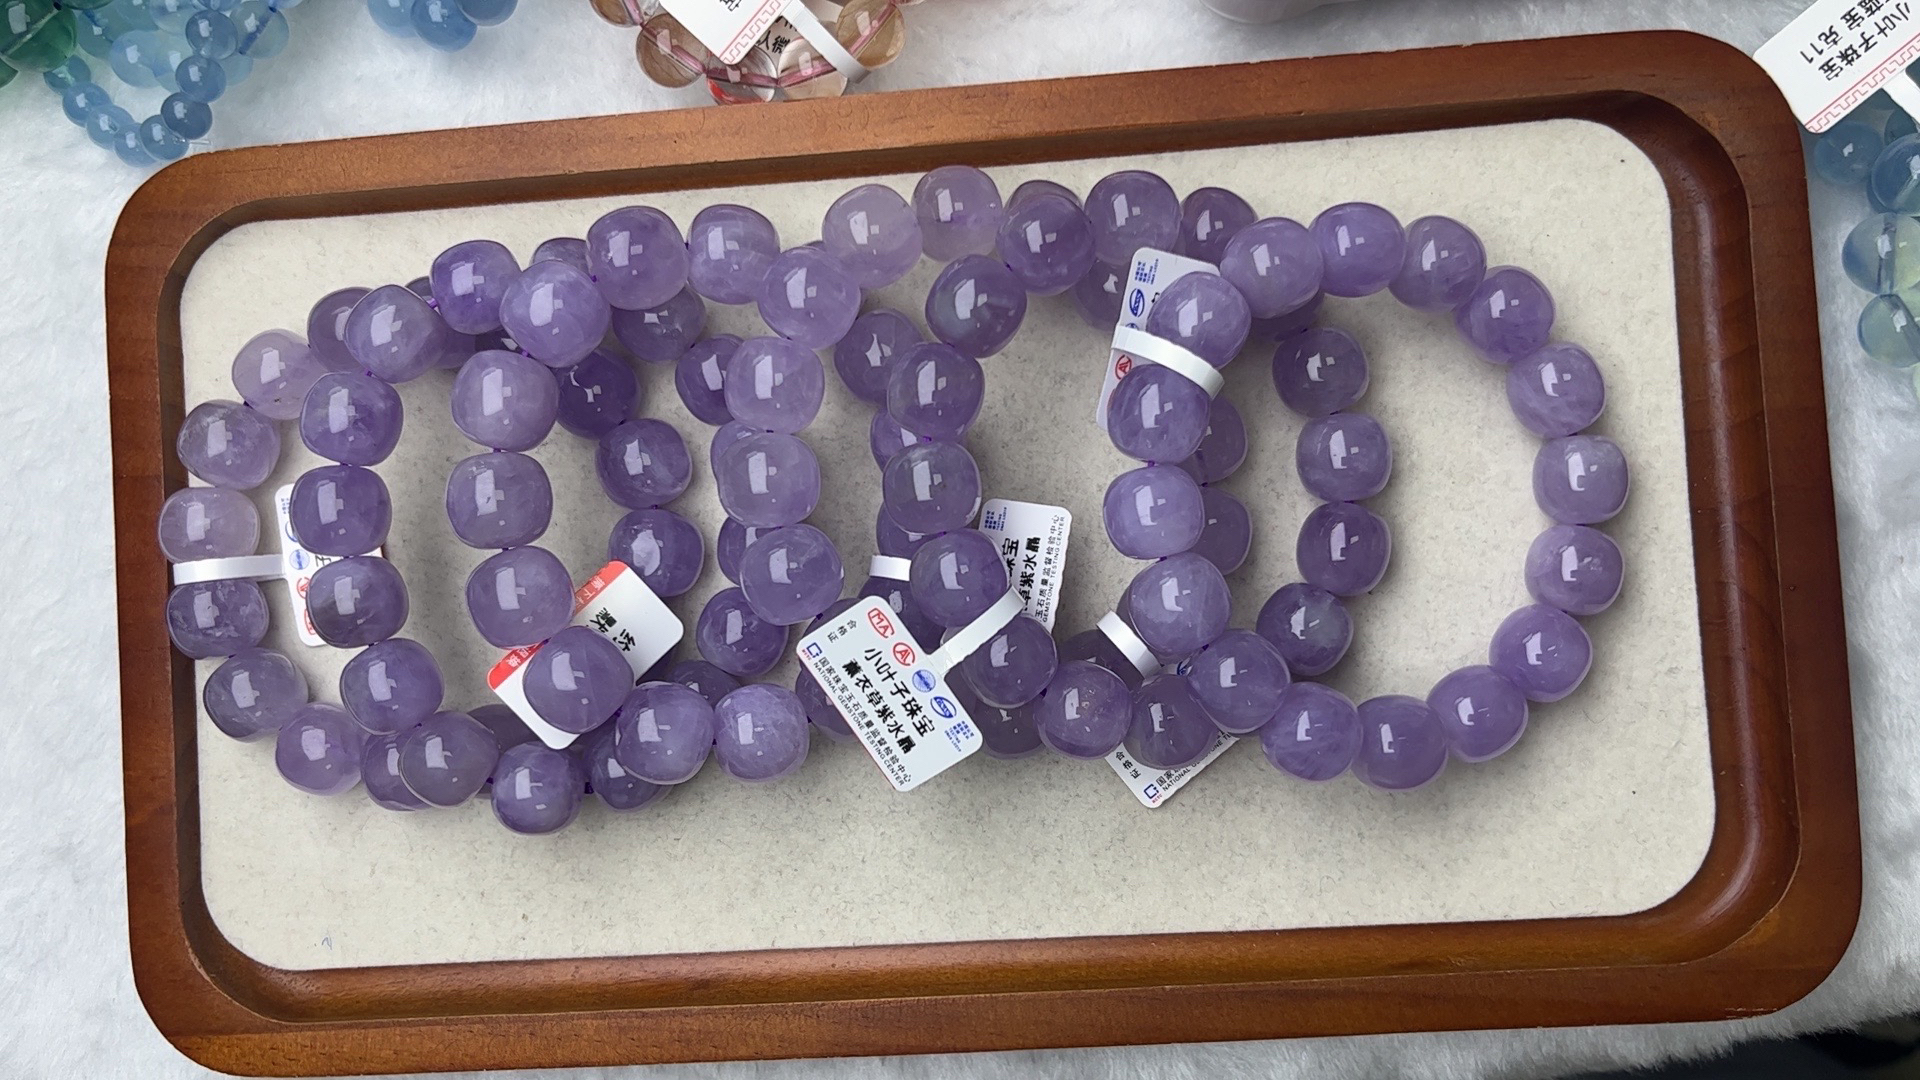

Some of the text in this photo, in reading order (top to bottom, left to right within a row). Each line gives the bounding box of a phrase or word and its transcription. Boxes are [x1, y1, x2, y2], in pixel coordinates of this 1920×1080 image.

[1818, 2, 1911, 80] 小叶子珠宝
[1050, 548, 1060, 578] TESTING
[1057, 516, 1065, 546] CENTER
[828, 619, 858, 644] 合格证
[814, 662, 905, 786] NATIONAL GEMSTONE TESTING CENTER
[818, 657, 912, 783] 国家珠宝玉石质量监督检验中心
[863, 647, 936, 738] 小叶子珠宝
[1115, 752, 1142, 779] 合格证
[1162, 768, 1191, 792] NATIONAL
